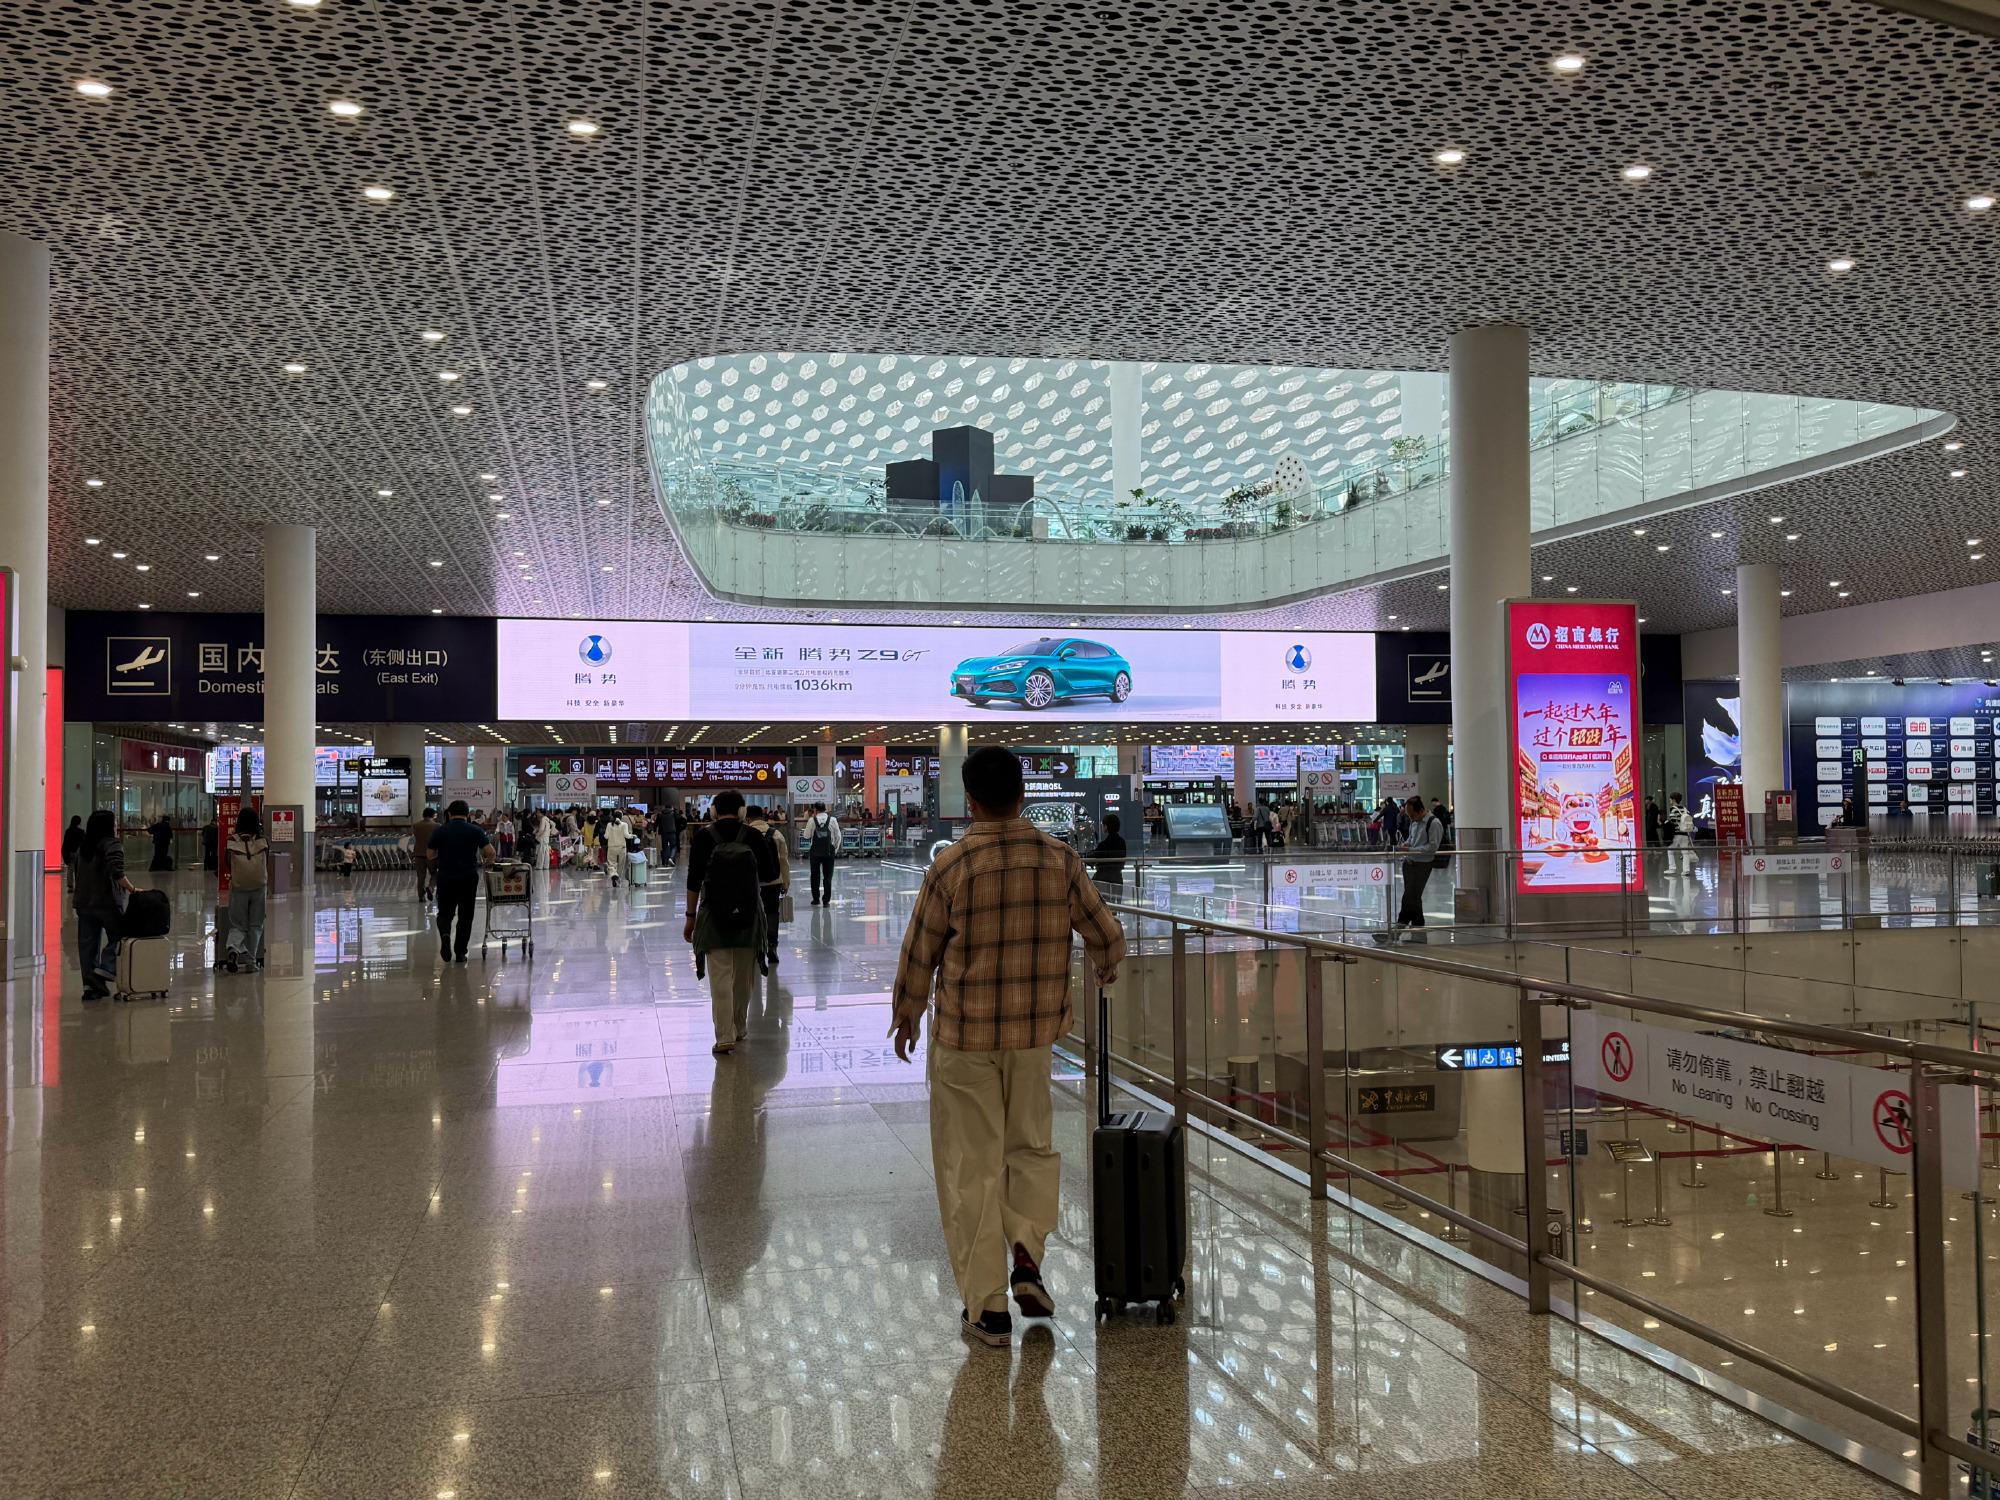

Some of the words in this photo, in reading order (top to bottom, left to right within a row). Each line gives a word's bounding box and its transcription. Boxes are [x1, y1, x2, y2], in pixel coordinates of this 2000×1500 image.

[1555, 626, 1619, 642] 招商银行
[198, 642, 341, 674] 国内达
[734, 646, 783, 661] 全新
[799, 647, 850, 661] 腾势
[376, 672, 408, 686] (East
[411, 672, 439, 686] Exit)
[575, 673, 617, 684] 腾势
[794, 678, 853, 691] 1036km
[1282, 679, 1316, 690] 腾势
[198, 679, 264, 694] Domesti
[1523, 700, 1619, 726] 一起过大年
[1672, 1078, 1687, 1094] No
[1692, 1083, 1733, 1109] Leaning
[1745, 1095, 1762, 1113] No
[1768, 1101, 1819, 1131] Crossing
